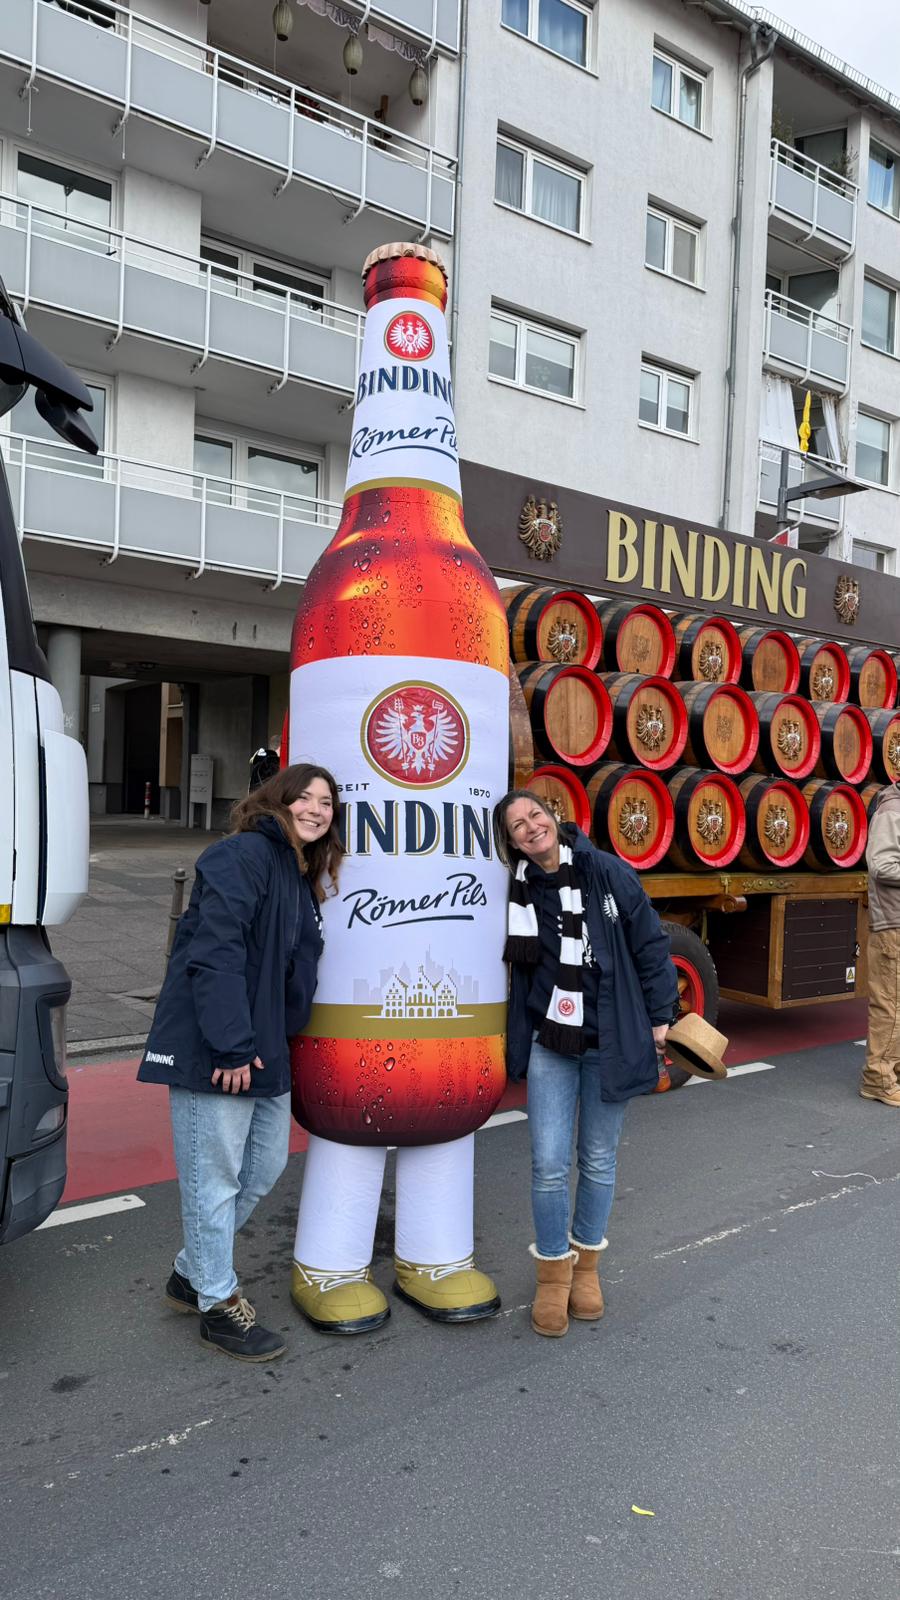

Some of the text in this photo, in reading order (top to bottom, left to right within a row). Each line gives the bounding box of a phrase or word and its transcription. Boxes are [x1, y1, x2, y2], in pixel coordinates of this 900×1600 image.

[352, 425, 439, 458] Römer
[605, 509, 808, 619] BINDING
[336, 782, 491, 799] SEIT 1870
[338, 800, 493, 860] INDIN
[342, 872, 488, 929] Römer Pils
[145, 1050, 175, 1067] BINDING
